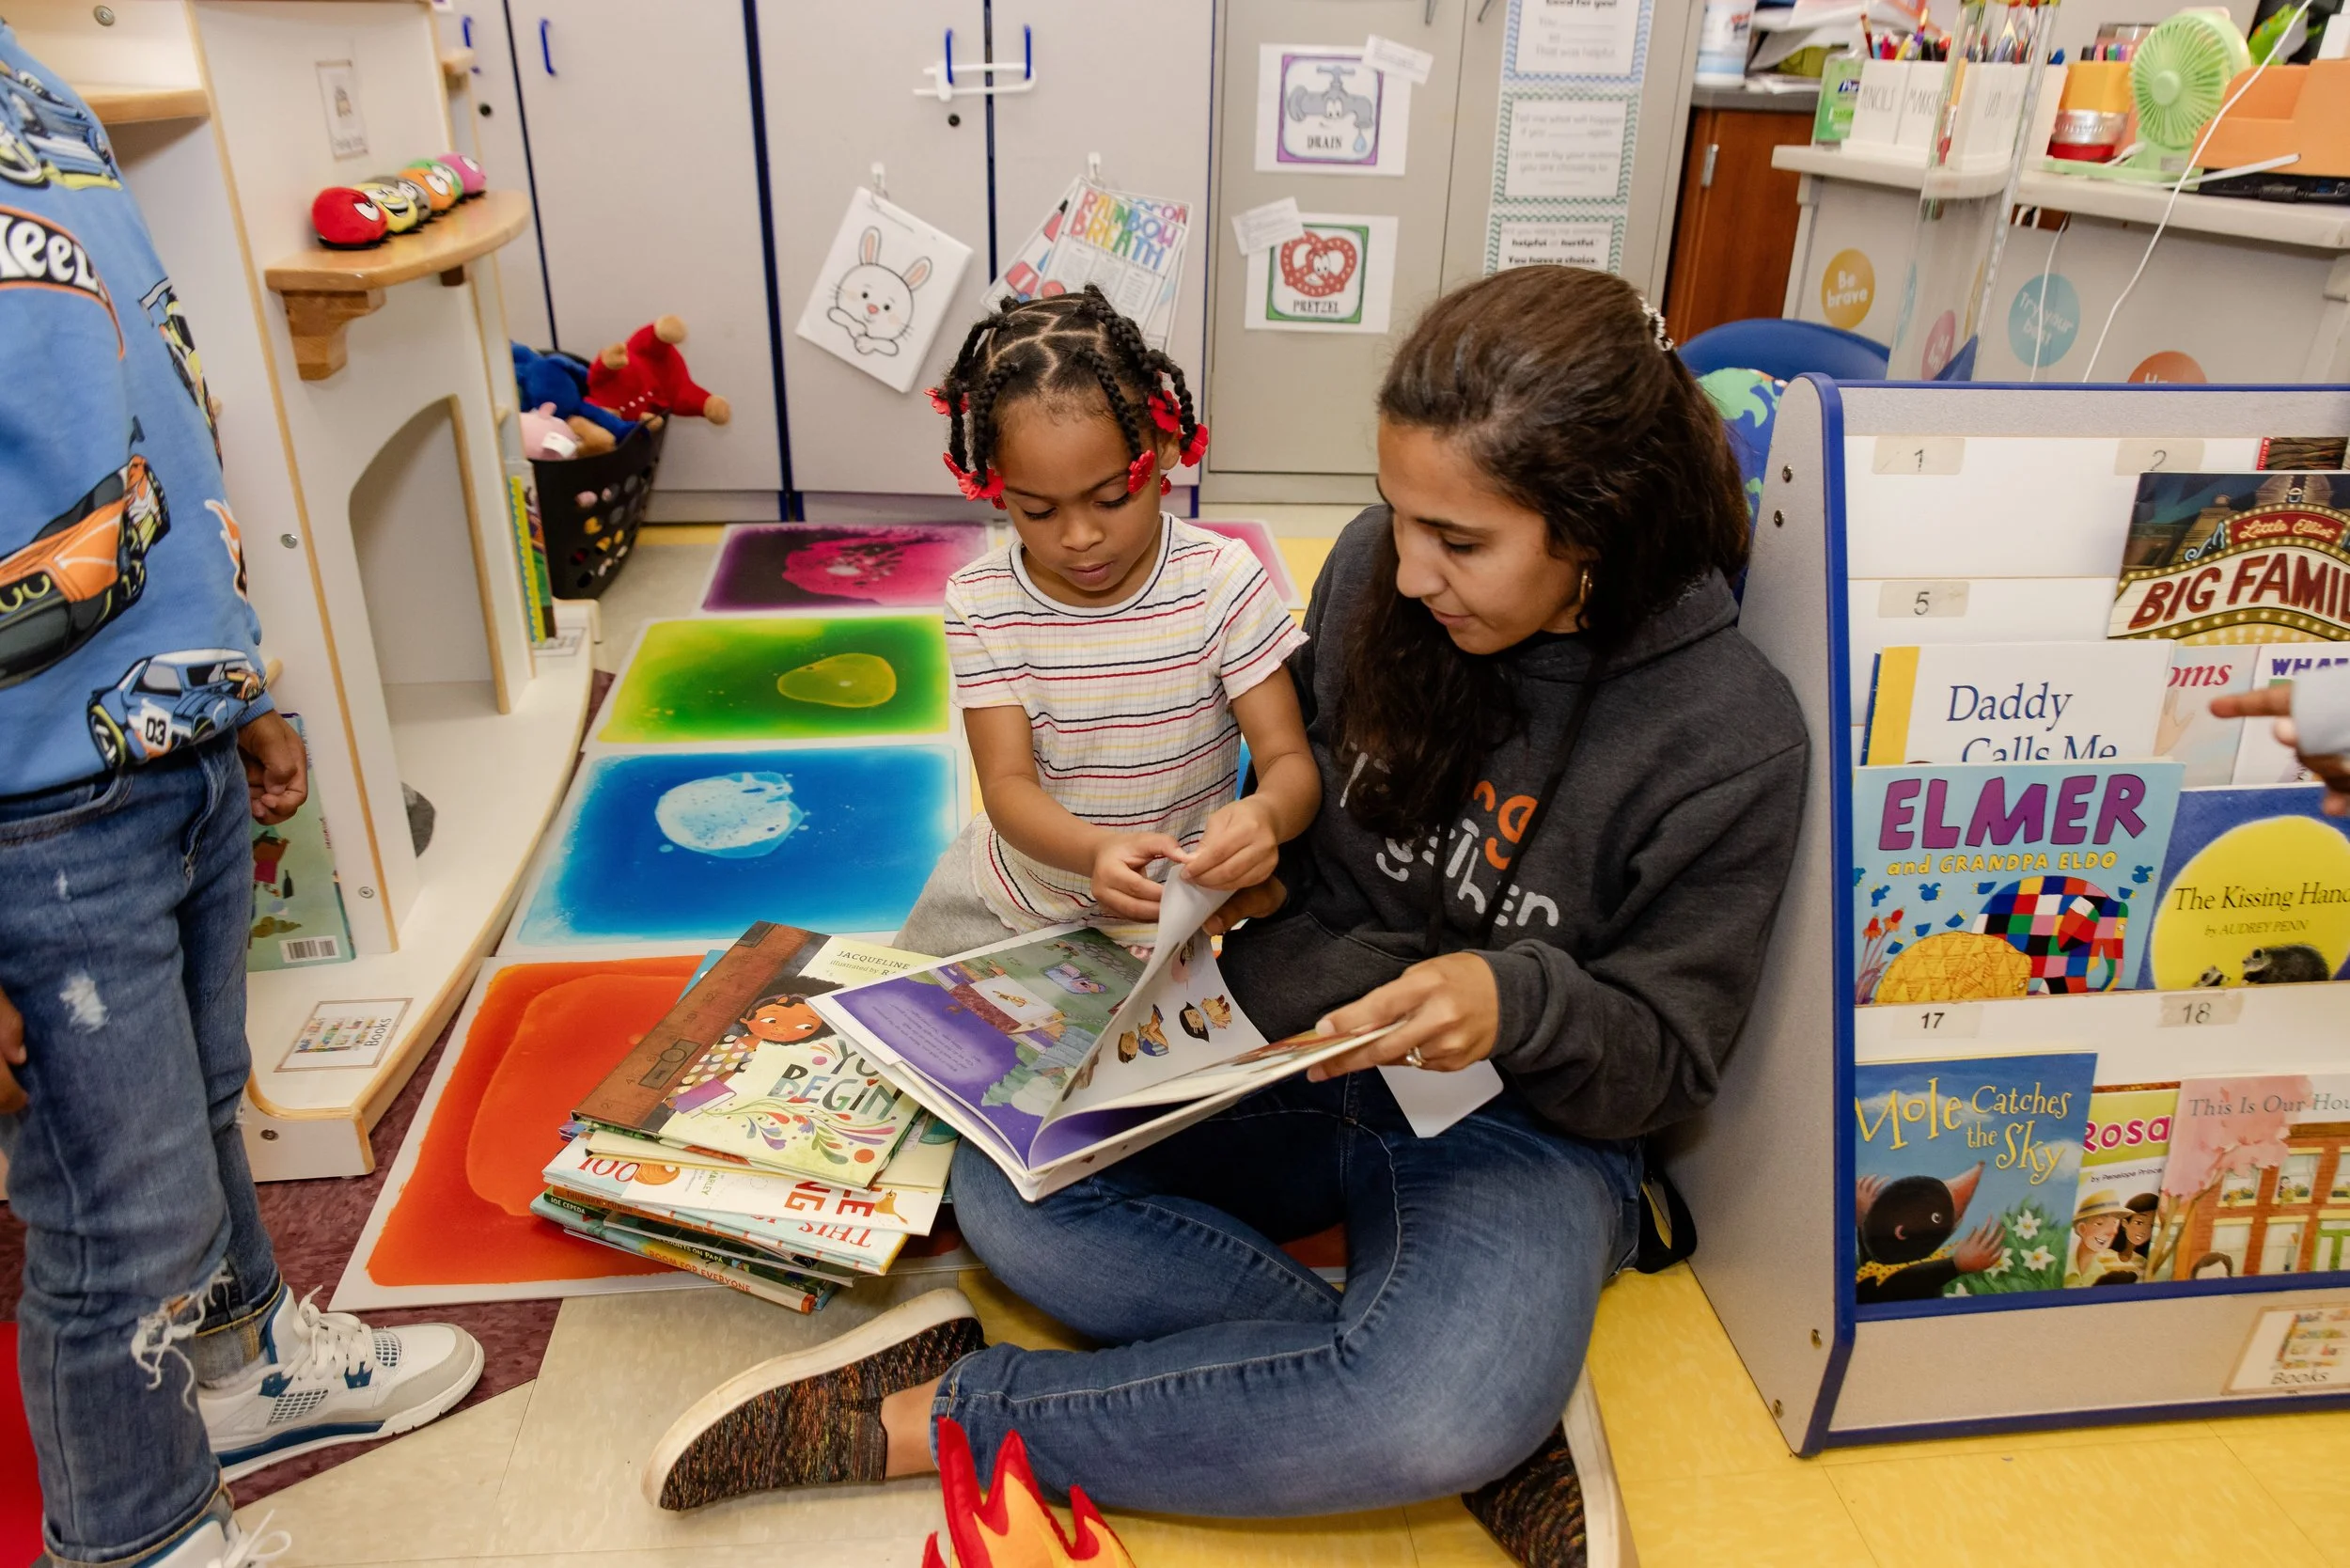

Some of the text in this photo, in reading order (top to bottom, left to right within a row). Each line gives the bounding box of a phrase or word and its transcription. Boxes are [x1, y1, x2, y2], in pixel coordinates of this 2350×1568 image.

[1307, 134, 1342, 150] DRAIN
[1082, 188, 1177, 248] RAINBOW
[1070, 209, 1167, 271] BREATH
[1838, 270, 1856, 290] Be
[1292, 299, 1340, 314] PRETZEL
[1826, 287, 1869, 308] brave
[2020, 291, 2074, 334] Try your
[2023, 318, 2052, 346] bet
[1914, 448, 1925, 472] 1
[2152, 449, 2168, 471] 2
[2238, 519, 2288, 540] Little
[1914, 590, 1930, 616] 5
[2128, 566, 2223, 630] BIG
[1946, 682, 2074, 732] Daddy
[145, 715, 167, 746] 03
[1962, 734, 2118, 763] Calls Me
[1878, 773, 2148, 852] ELMER
[1887, 851, 2119, 876] and GRANDPA ELDO
[2174, 886, 2216, 911] The
[2220, 885, 2294, 912] Kissing
[2203, 918, 2310, 938] by AUDREY PENN
[830, 959, 870, 972] illustrated
[869, 966, 880, 975] by
[837, 950, 912, 970] JACQUELINE
[1920, 1011, 1946, 1029] 17
[2183, 1001, 2213, 1025] 18
[364, 1017, 393, 1047] Books
[767, 1063, 901, 1121] BEGIN
[1855, 1076, 2074, 1151] Mole Catches
[2187, 1096, 2232, 1118] This
[2238, 1096, 2256, 1115] Is
[2262, 1093, 2307, 1113] Our
[2082, 1113, 2173, 1155] Rosa
[1966, 1120, 2066, 1185] the Sky
[2090, 1174, 2102, 1184] by
[550, 1197, 586, 1215] JOE CEPEDA
[798, 1222, 871, 1248] THIS
[692, 1247, 704, 1257] ON
[649, 1249, 751, 1294] ROOM FOR EVERYONE
